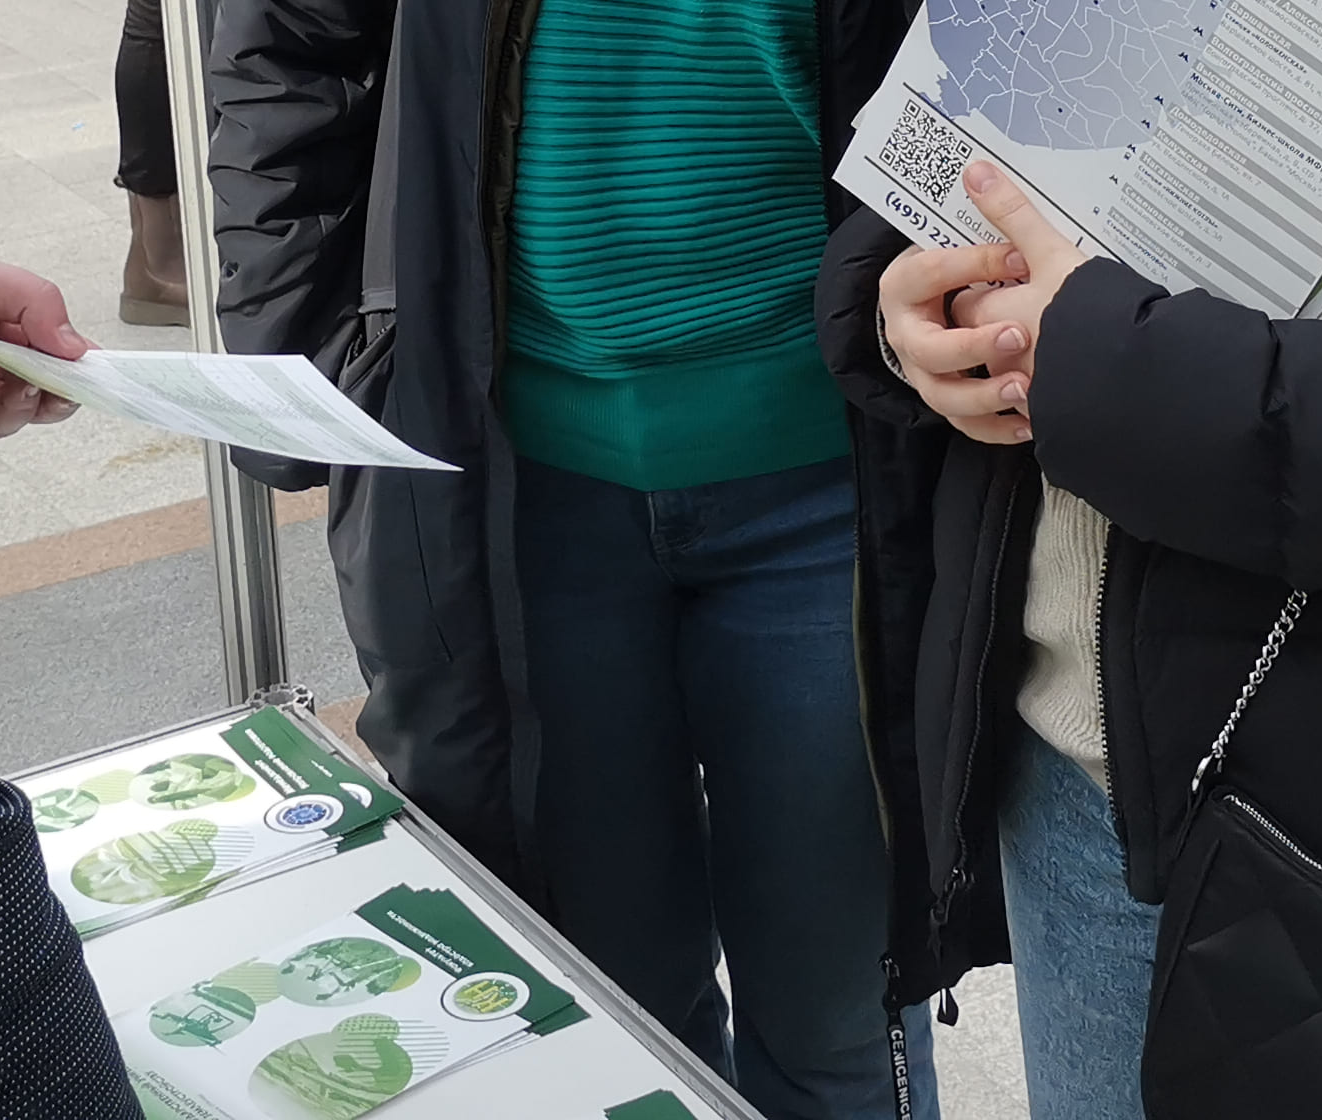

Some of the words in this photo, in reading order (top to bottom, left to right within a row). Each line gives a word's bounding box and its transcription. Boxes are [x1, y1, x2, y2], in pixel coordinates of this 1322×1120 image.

[1228, 1, 1294, 50] Варшавская
[1194, 62, 1261, 112] Выставочная
[1208, 36, 1286, 94] Волгоградский
[1188, 72, 1248, 118] Москва-Сити,
[1244, 113, 1306, 159] Бизнес-школа
[1154, 129, 1211, 173] Калужская
[1139, 154, 1203, 203] Нагатинская
[880, 188, 932, 232] (495)
[953, 207, 1005, 248] dod.mf
